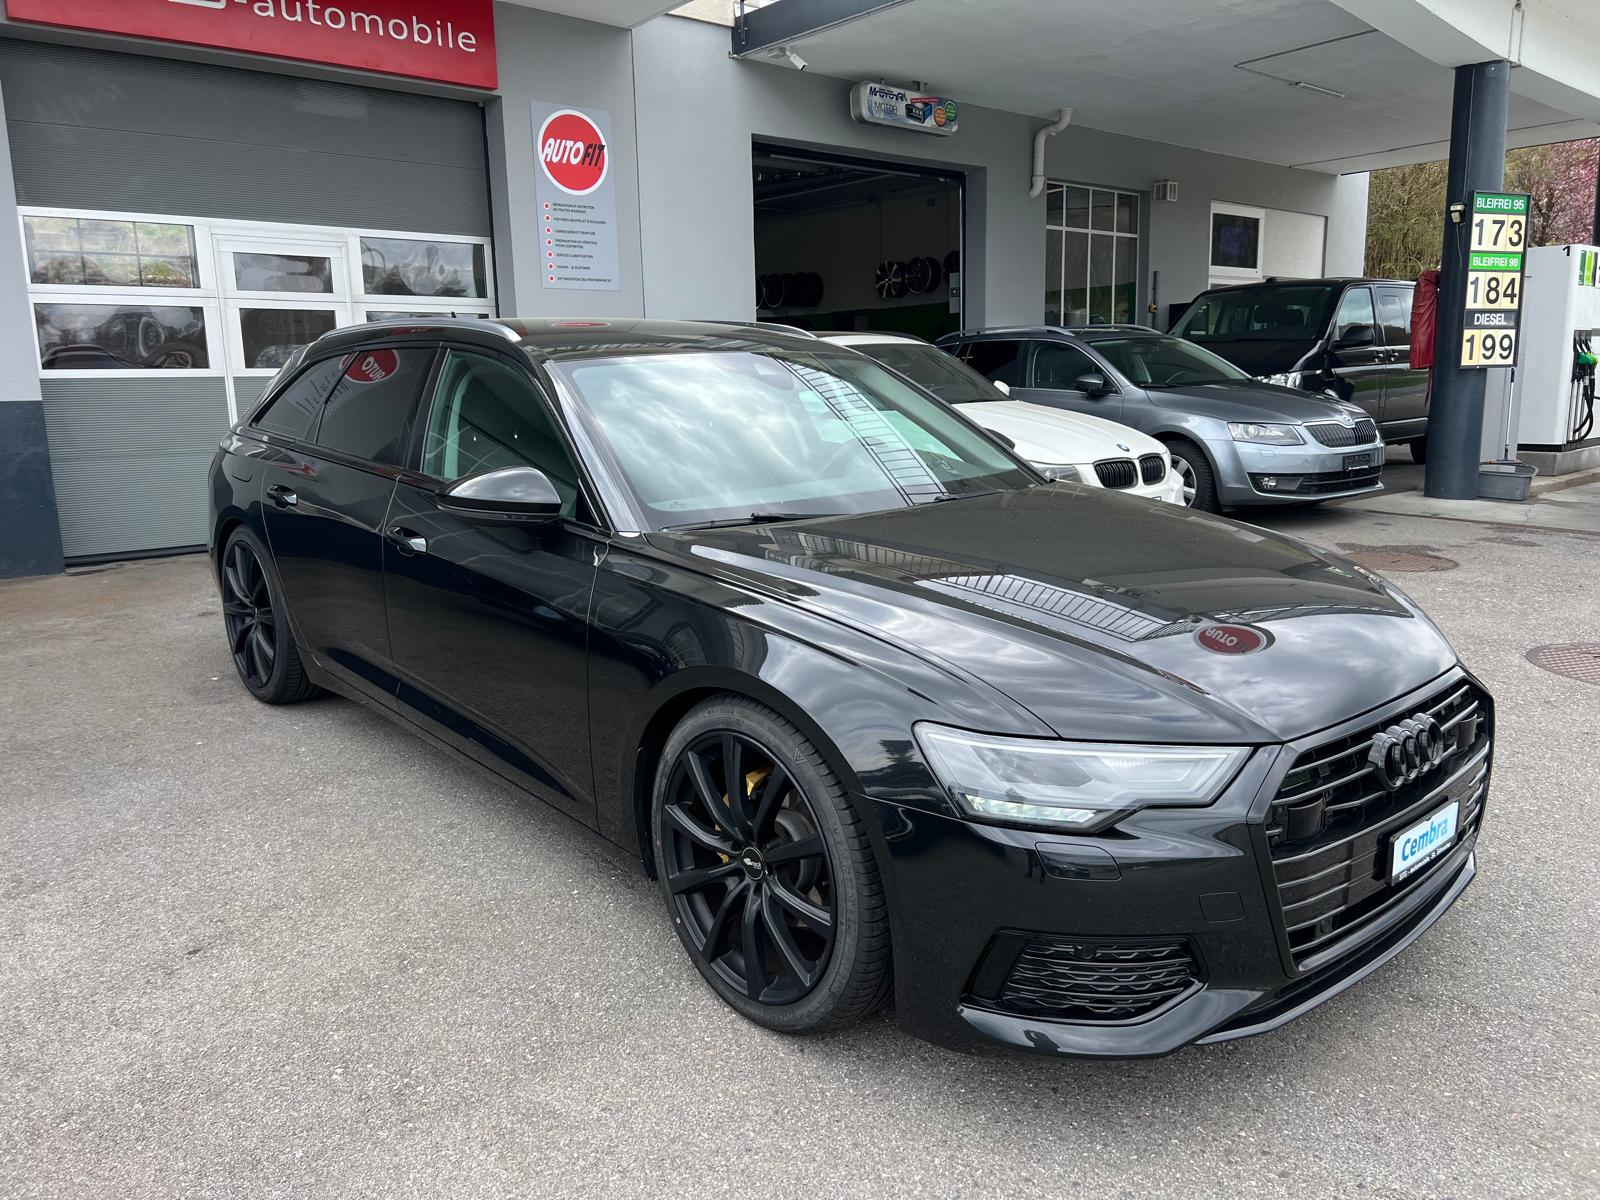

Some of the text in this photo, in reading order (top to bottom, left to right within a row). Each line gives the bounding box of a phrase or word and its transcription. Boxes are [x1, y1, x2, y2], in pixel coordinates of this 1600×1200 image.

[1476, 197, 1524, 210] BLEIFREI 95
[1475, 218, 1523, 247] 173
[1562, 245, 1570, 256] 1
[1472, 256, 1507, 267] BLEIFREI
[1470, 277, 1517, 304] 184
[1474, 313, 1507, 326] DIESEL
[1465, 334, 1513, 360] 199
[1401, 818, 1449, 862] Cembra
